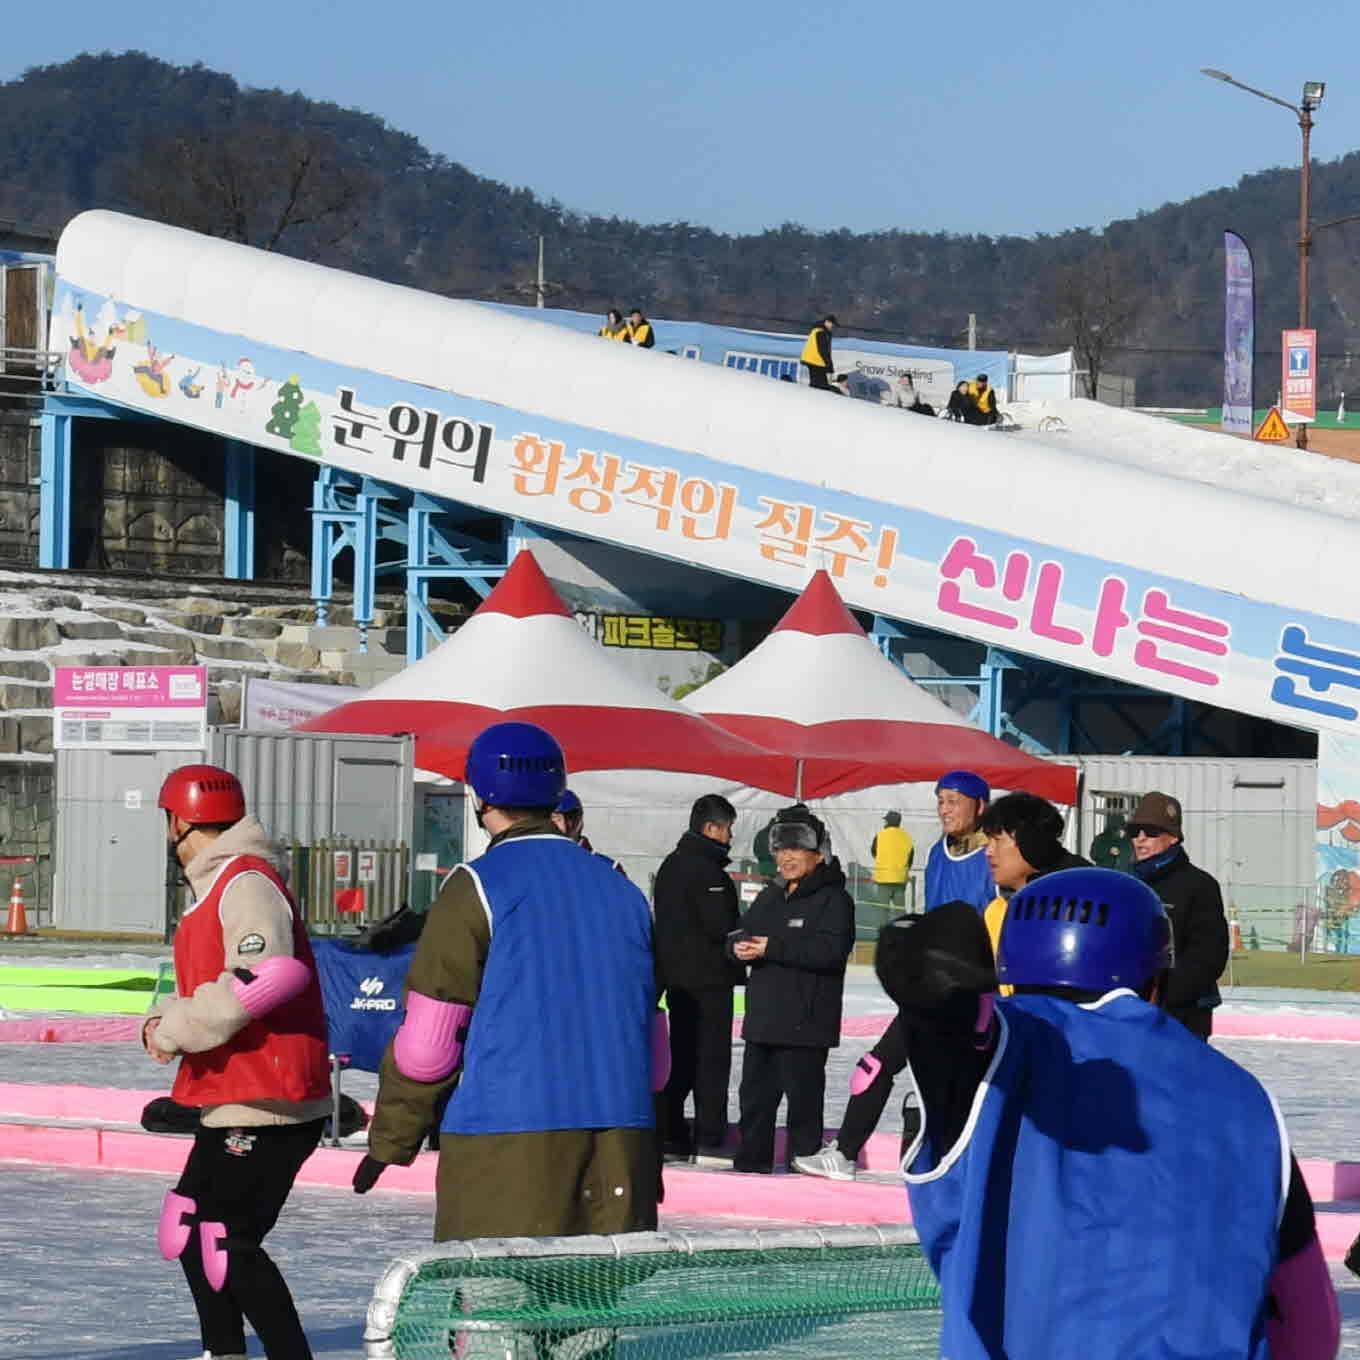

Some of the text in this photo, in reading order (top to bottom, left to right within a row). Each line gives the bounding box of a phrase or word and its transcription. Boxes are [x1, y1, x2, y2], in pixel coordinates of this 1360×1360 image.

[331, 389, 495, 484] 눈위의
[511, 433, 738, 542] 환상적인
[755, 493, 898, 589] 질주!
[937, 536, 1230, 687] 신나는
